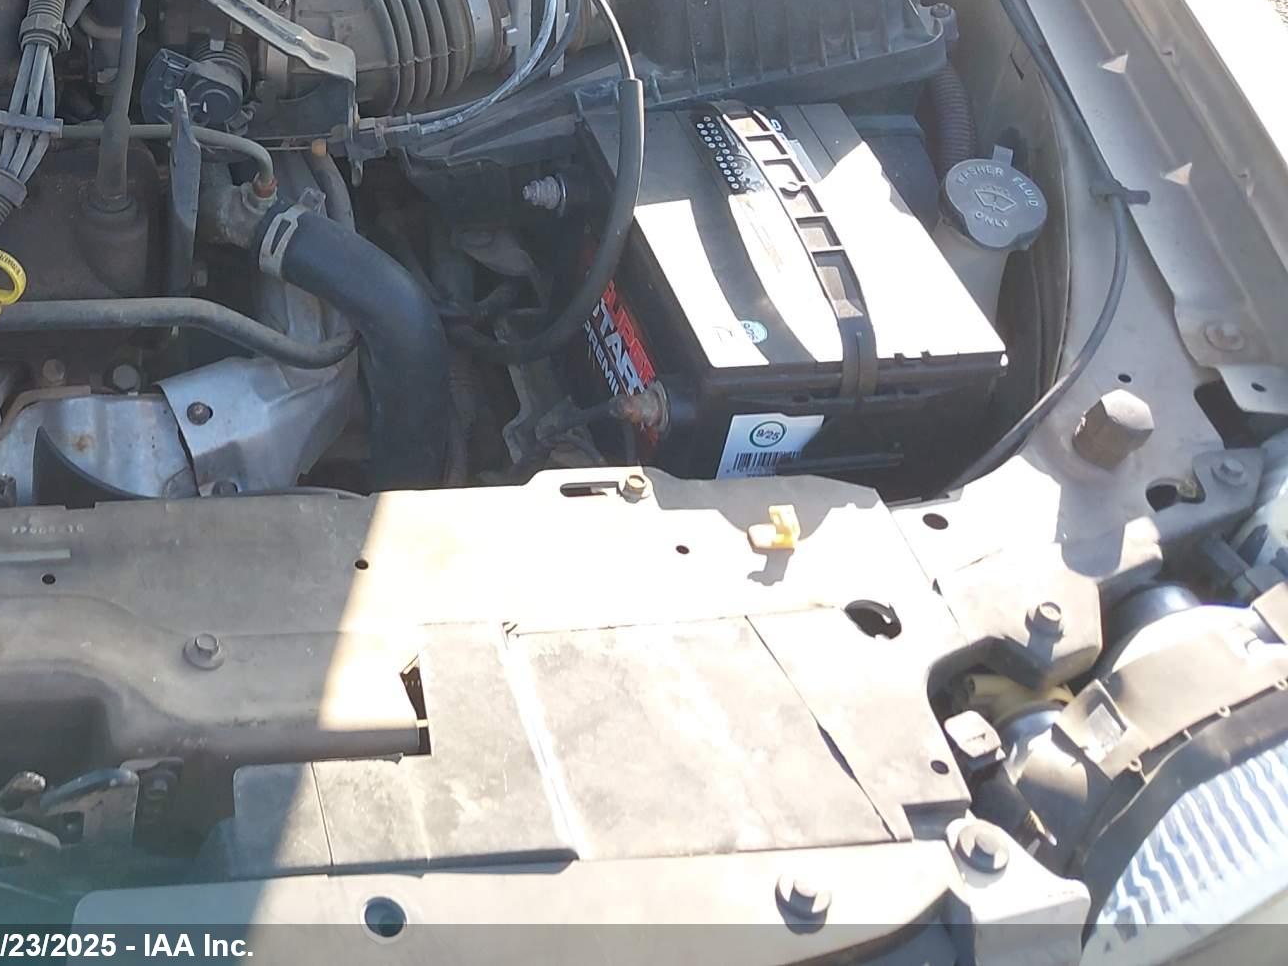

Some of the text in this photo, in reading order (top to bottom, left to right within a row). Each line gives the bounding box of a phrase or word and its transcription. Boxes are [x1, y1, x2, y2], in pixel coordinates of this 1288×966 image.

[957, 164, 1039, 207] WASHER FLUID
[975, 211, 1009, 227] ONLY
